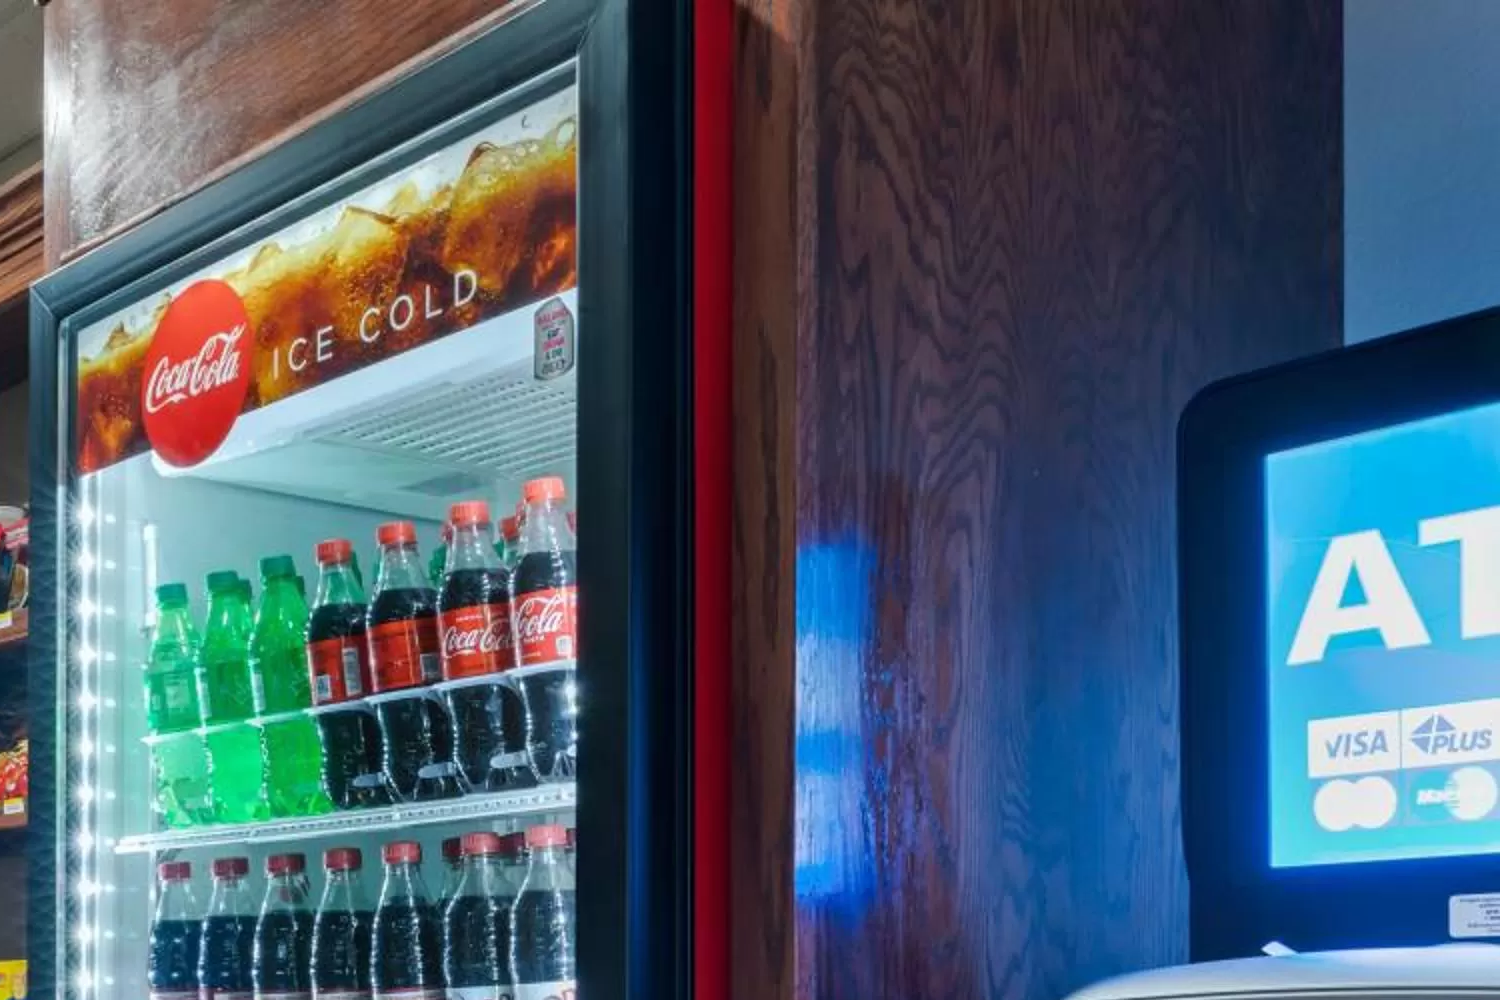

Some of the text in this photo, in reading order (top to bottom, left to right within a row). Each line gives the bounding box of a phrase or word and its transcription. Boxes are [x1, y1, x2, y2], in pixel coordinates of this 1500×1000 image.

[272, 268, 478, 381] ICE COLD
[1325, 729, 1390, 759] VISA
[1430, 727, 1493, 756] PLUS
